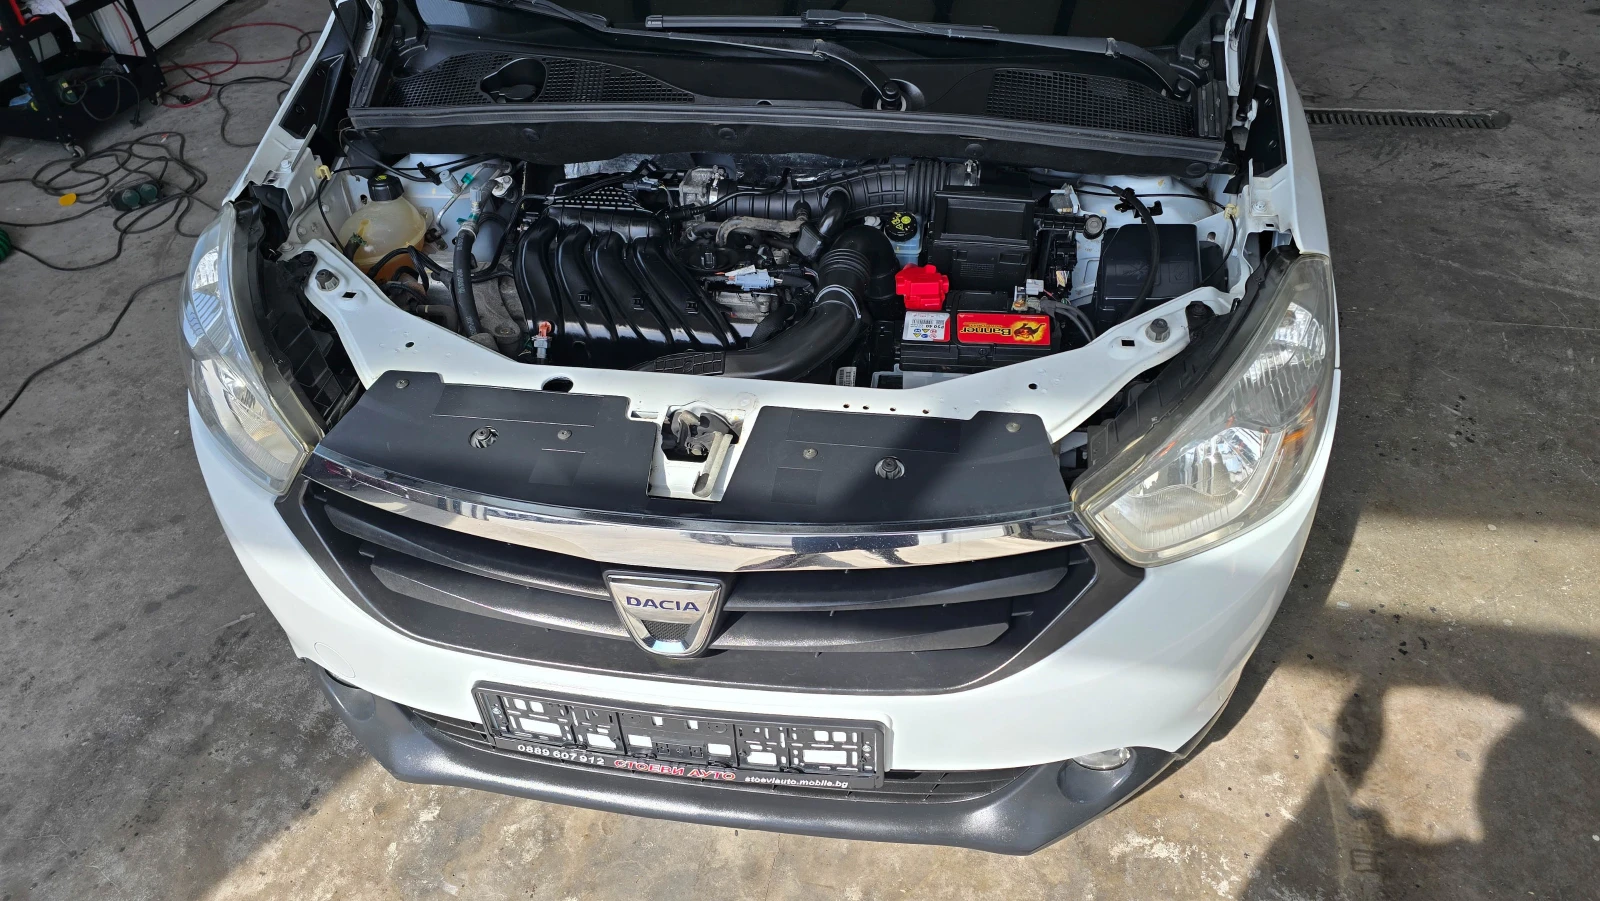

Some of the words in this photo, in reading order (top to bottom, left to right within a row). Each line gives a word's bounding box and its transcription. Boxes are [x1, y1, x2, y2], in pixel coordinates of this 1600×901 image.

[960, 326, 1012, 336] Banner
[626, 596, 700, 612] DACIA
[517, 744, 550, 756] 0889
[553, 750, 577, 761] 607
[580, 755, 605, 765] 912
[614, 759, 685, 776] СТОЕВИ
[687, 768, 736, 780] АУТО
[744, 776, 849, 789] stoeviauto.mobile.bg
